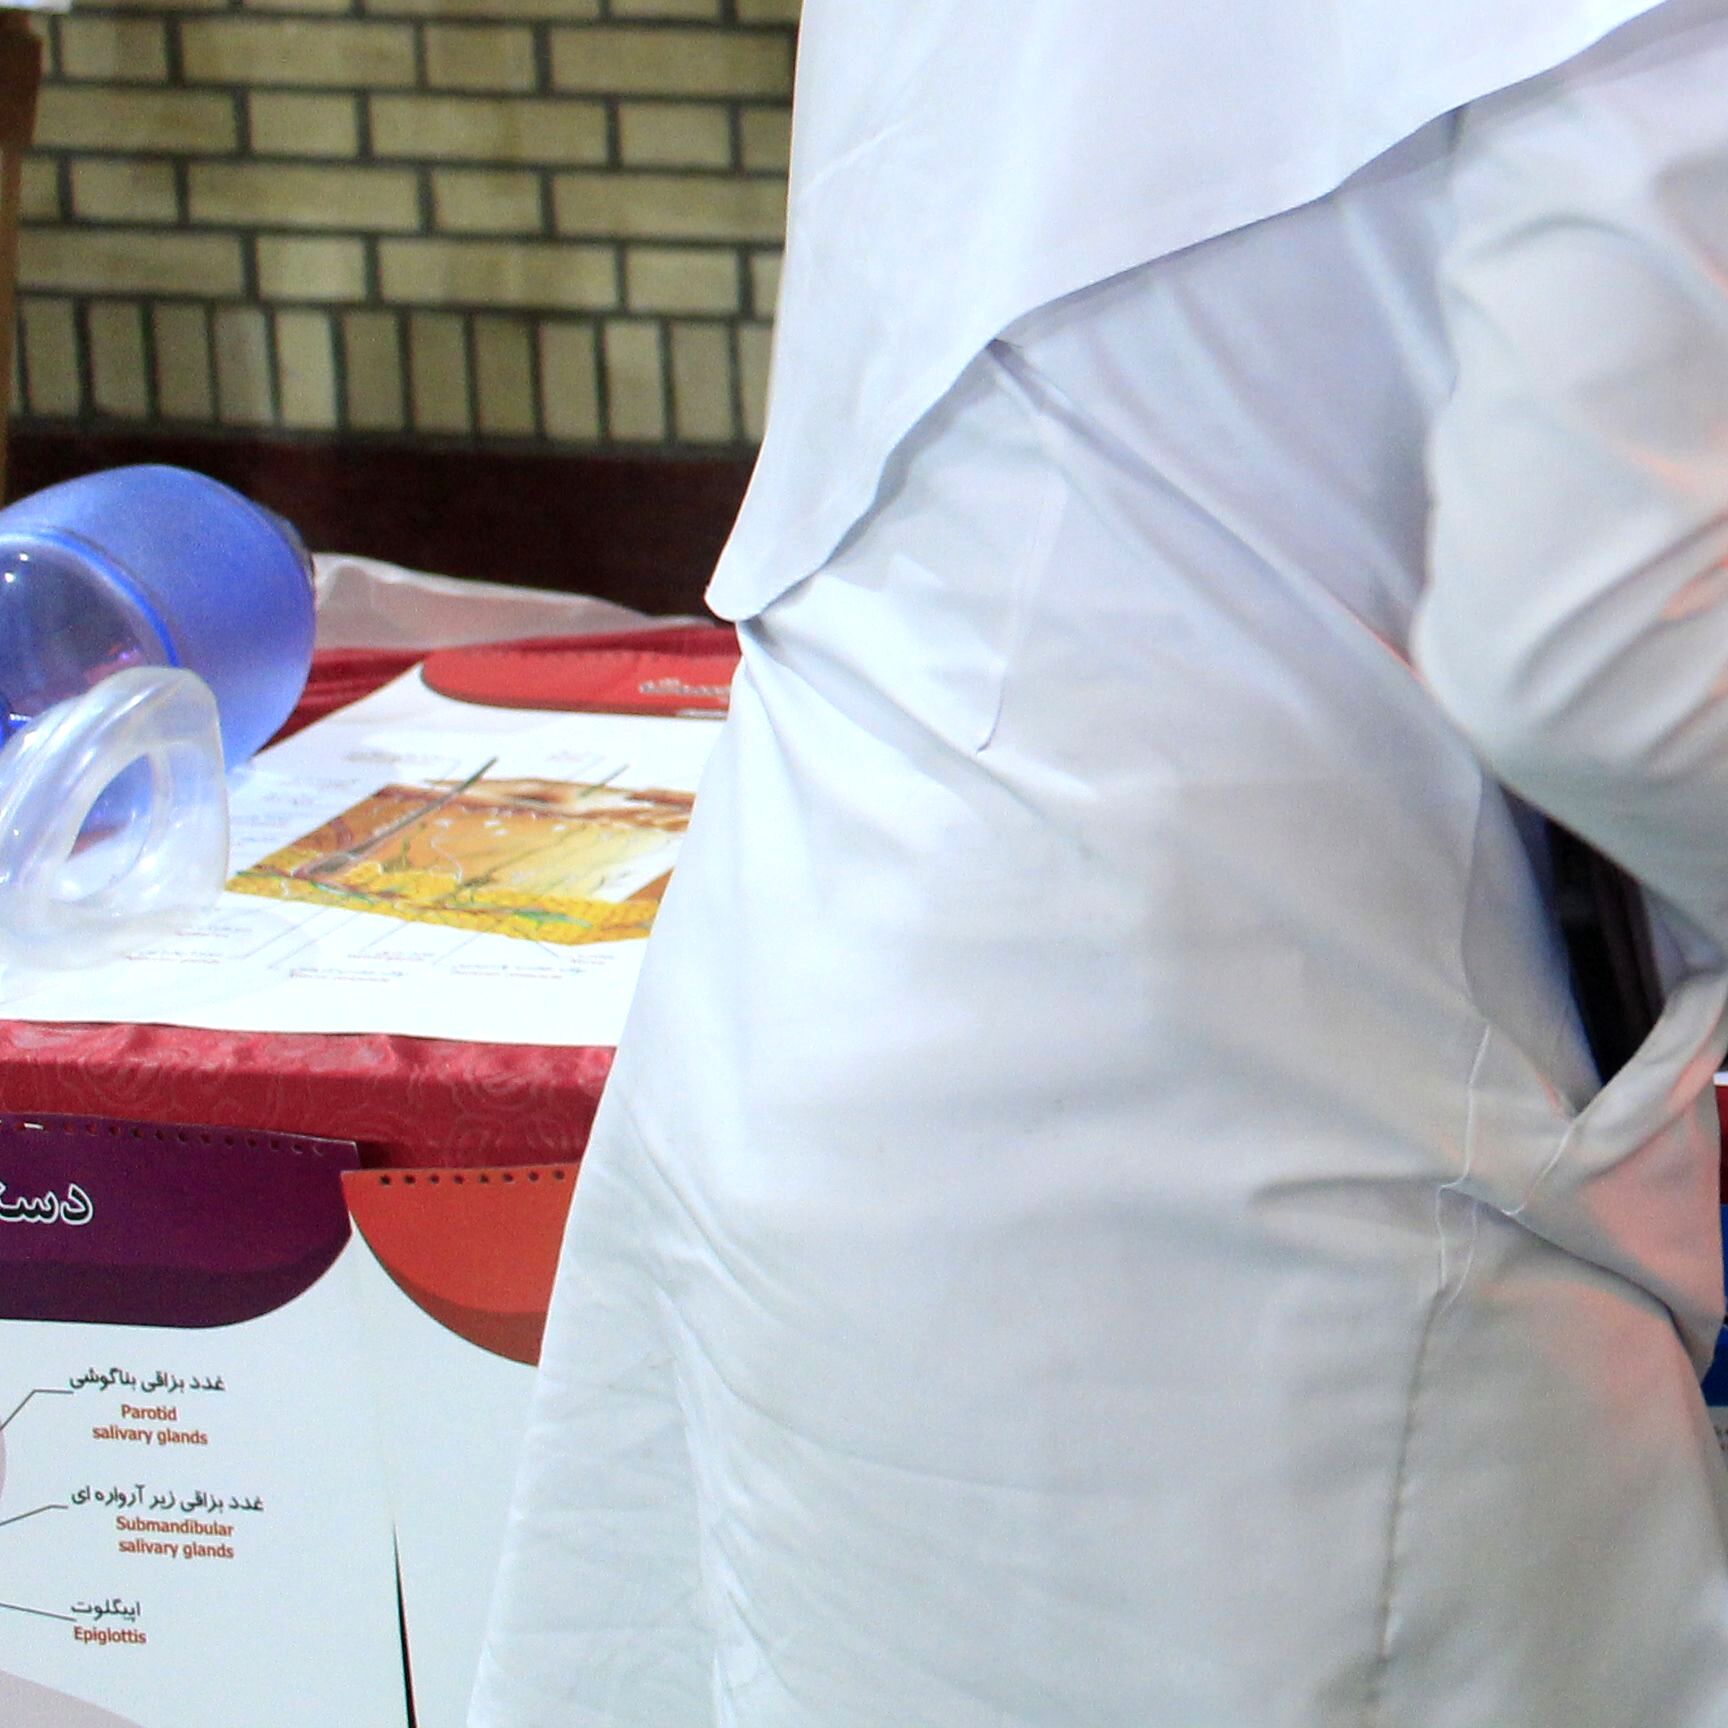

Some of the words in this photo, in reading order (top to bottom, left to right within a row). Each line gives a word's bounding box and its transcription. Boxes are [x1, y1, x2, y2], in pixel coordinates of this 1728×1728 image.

[69, 1367, 137, 1391] بناگوشی
[141, 1370, 185, 1393] بزاقی
[189, 1374, 226, 1392] غدد
[121, 1404, 178, 1422] Parotid
[92, 1424, 153, 1445] salivary
[157, 1428, 209, 1446] glands
[148, 1490, 176, 1510] زیر
[180, 1489, 224, 1514] بزاقی
[228, 1495, 265, 1512] غدد
[115, 1515, 235, 1538] Submandibular
[118, 1538, 180, 1559] salivary
[183, 1542, 235, 1560] glands
[70, 1598, 142, 1623] اپیگلوت
[73, 1625, 148, 1646] Epiglottis
